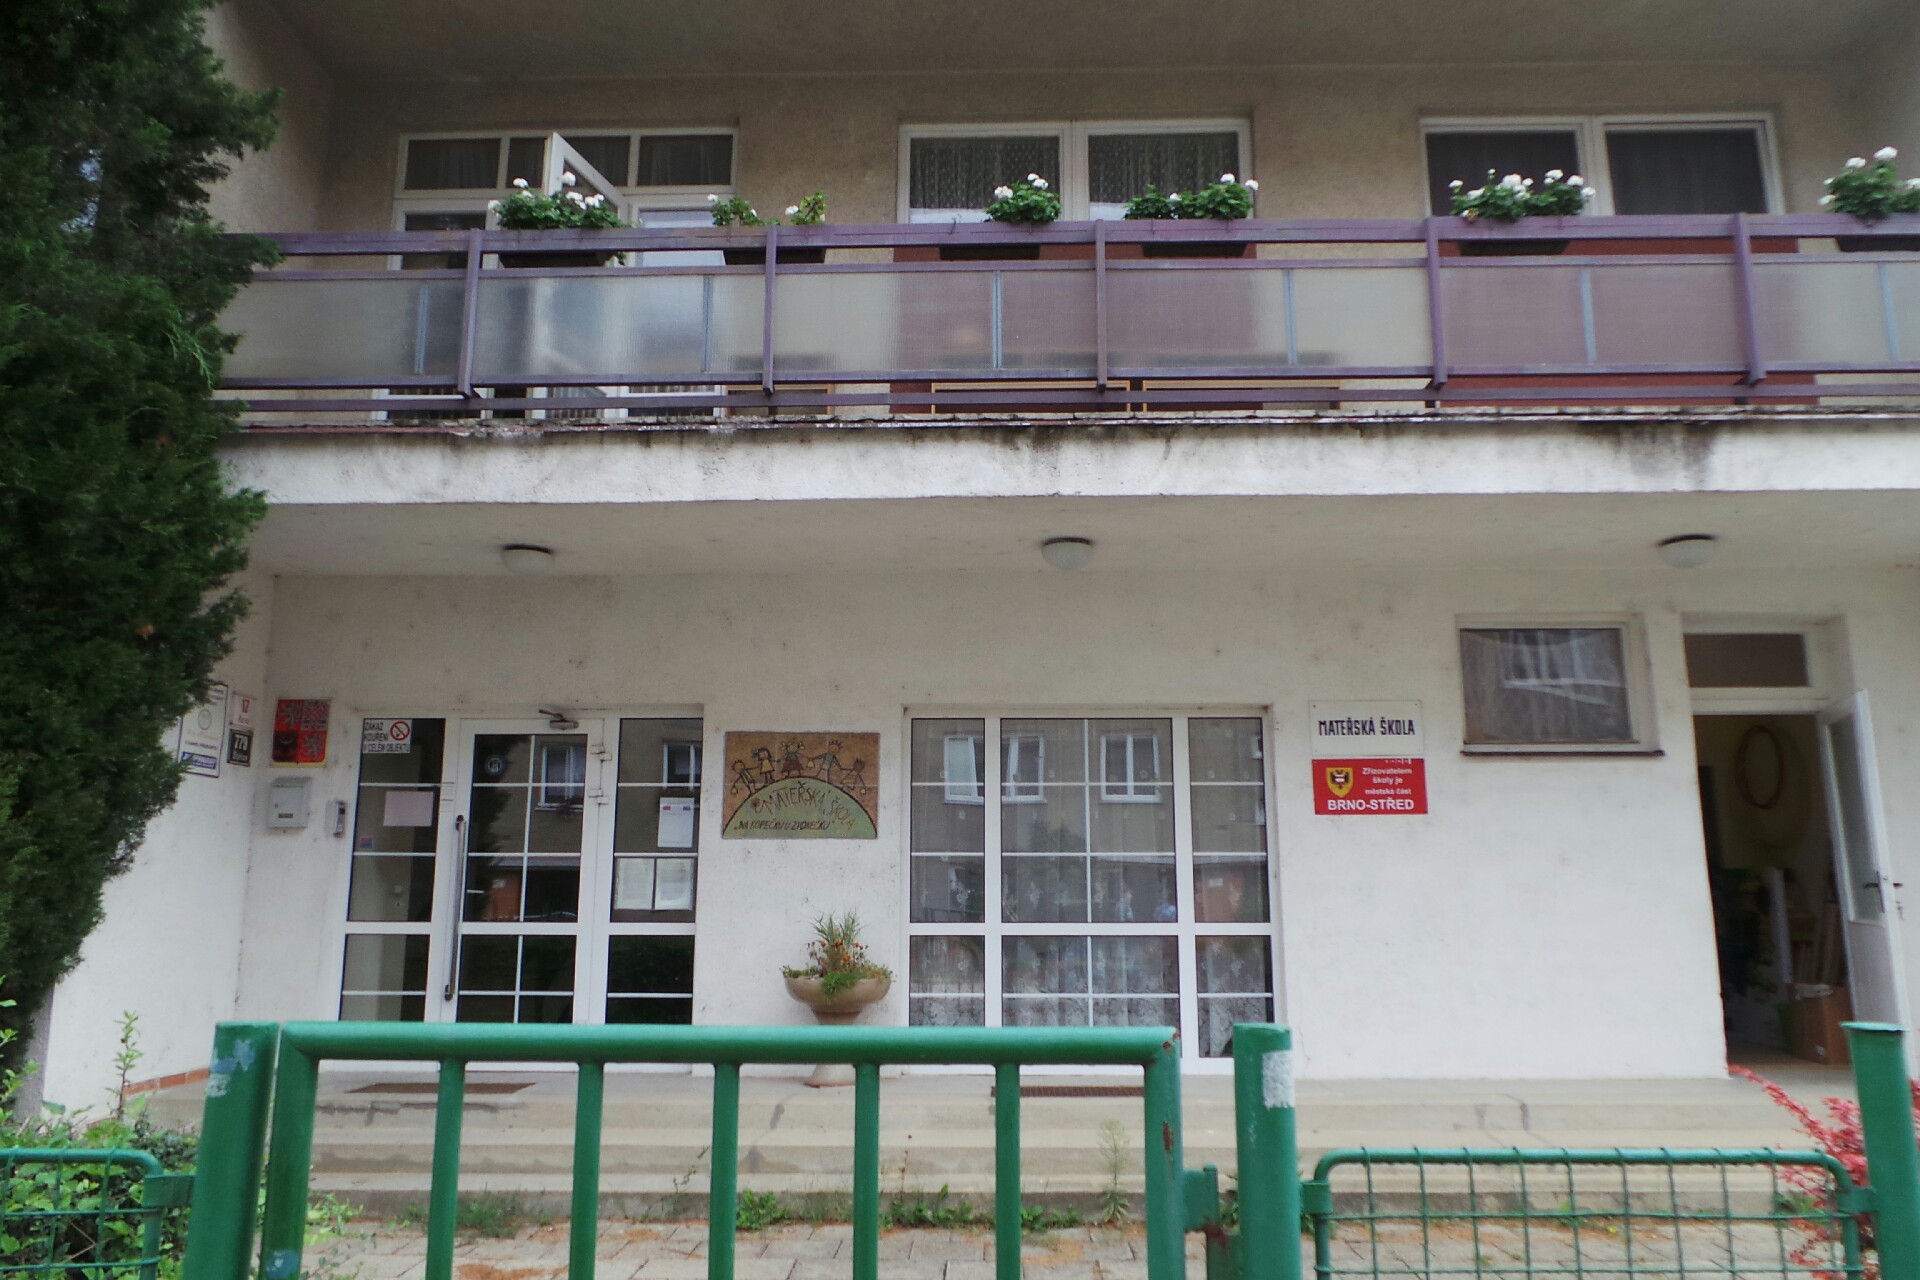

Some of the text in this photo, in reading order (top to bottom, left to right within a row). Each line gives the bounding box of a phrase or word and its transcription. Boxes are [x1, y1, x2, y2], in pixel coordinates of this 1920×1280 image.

[1318, 717, 1415, 735] MATEŘSKÁ ŠKOLA
[1373, 776, 1403, 785] školy je
[755, 781, 830, 815] MATEŘSKÁ
[1328, 797, 1414, 810] BRNO-STŘED
